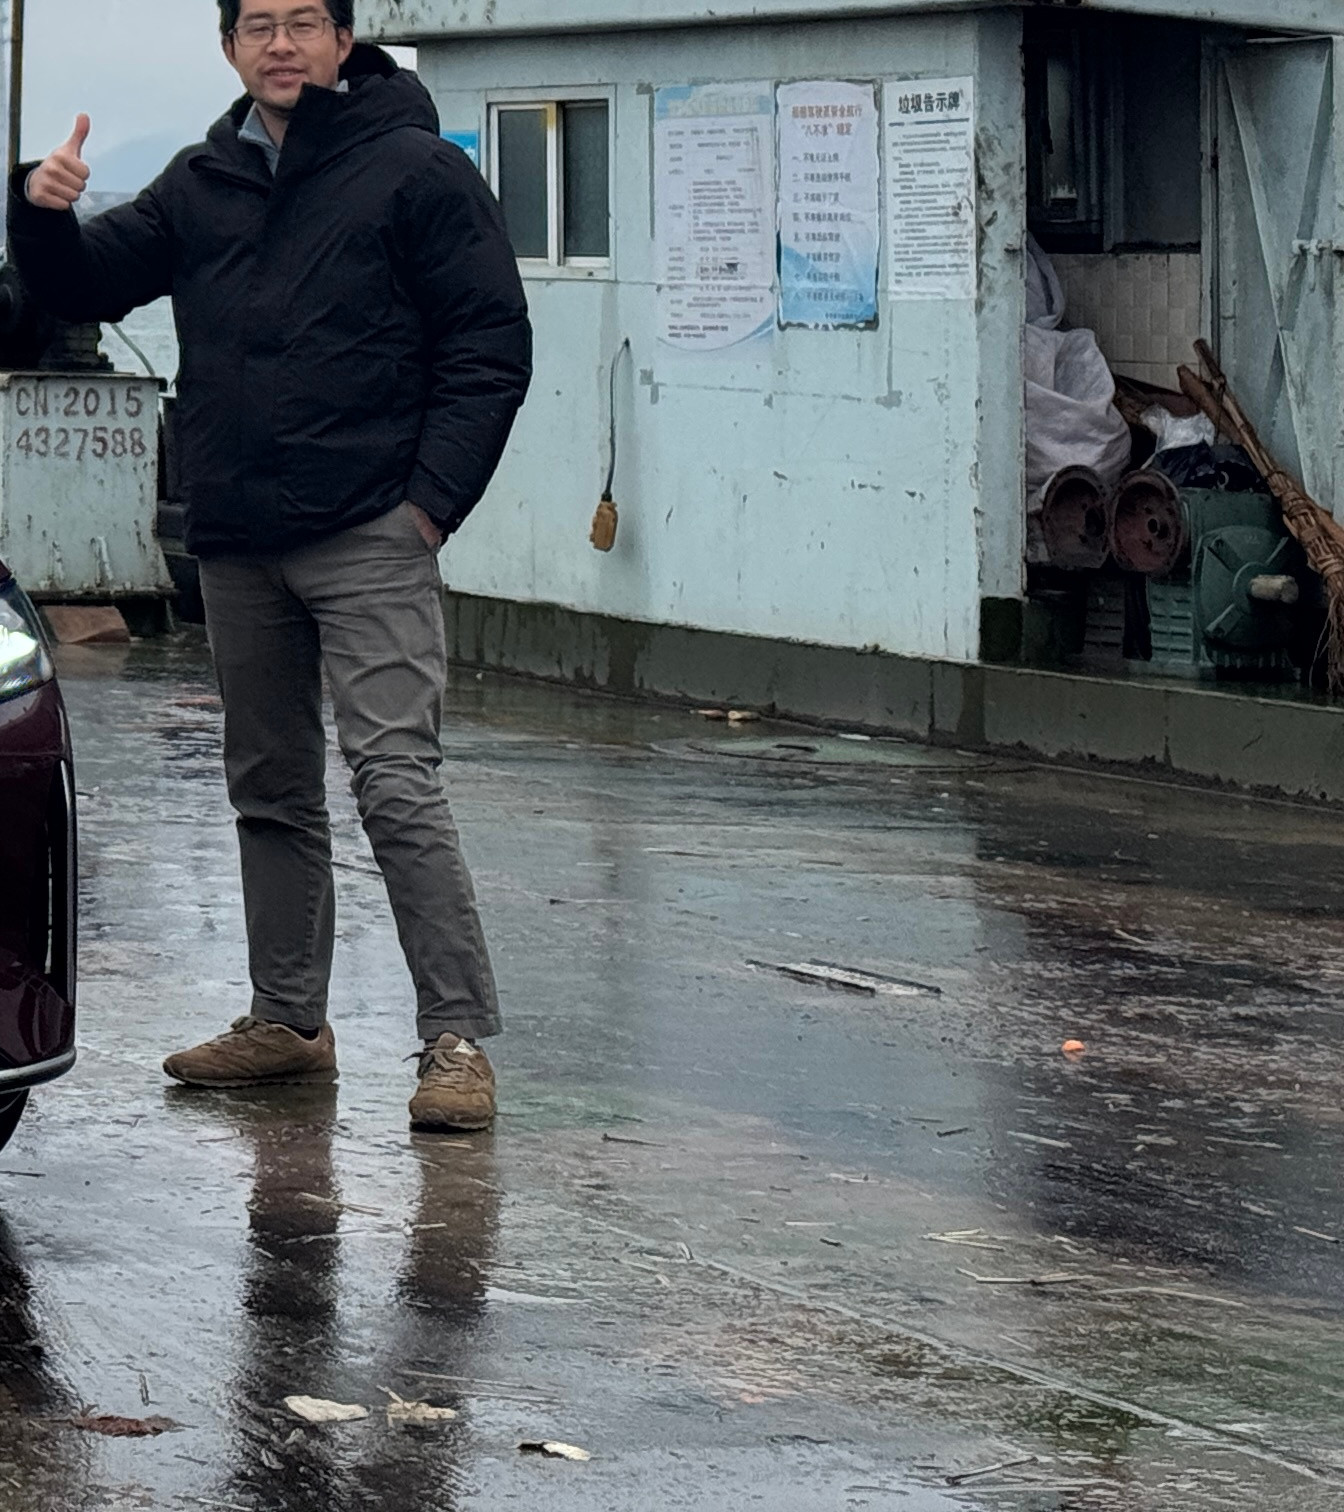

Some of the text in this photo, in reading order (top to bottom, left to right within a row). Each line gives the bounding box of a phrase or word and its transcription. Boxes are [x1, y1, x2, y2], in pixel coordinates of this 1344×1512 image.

[898, 91, 960, 114] 垃圾告示牌
[15, 386, 144, 418] CN:2015
[16, 425, 148, 462] 4327588
